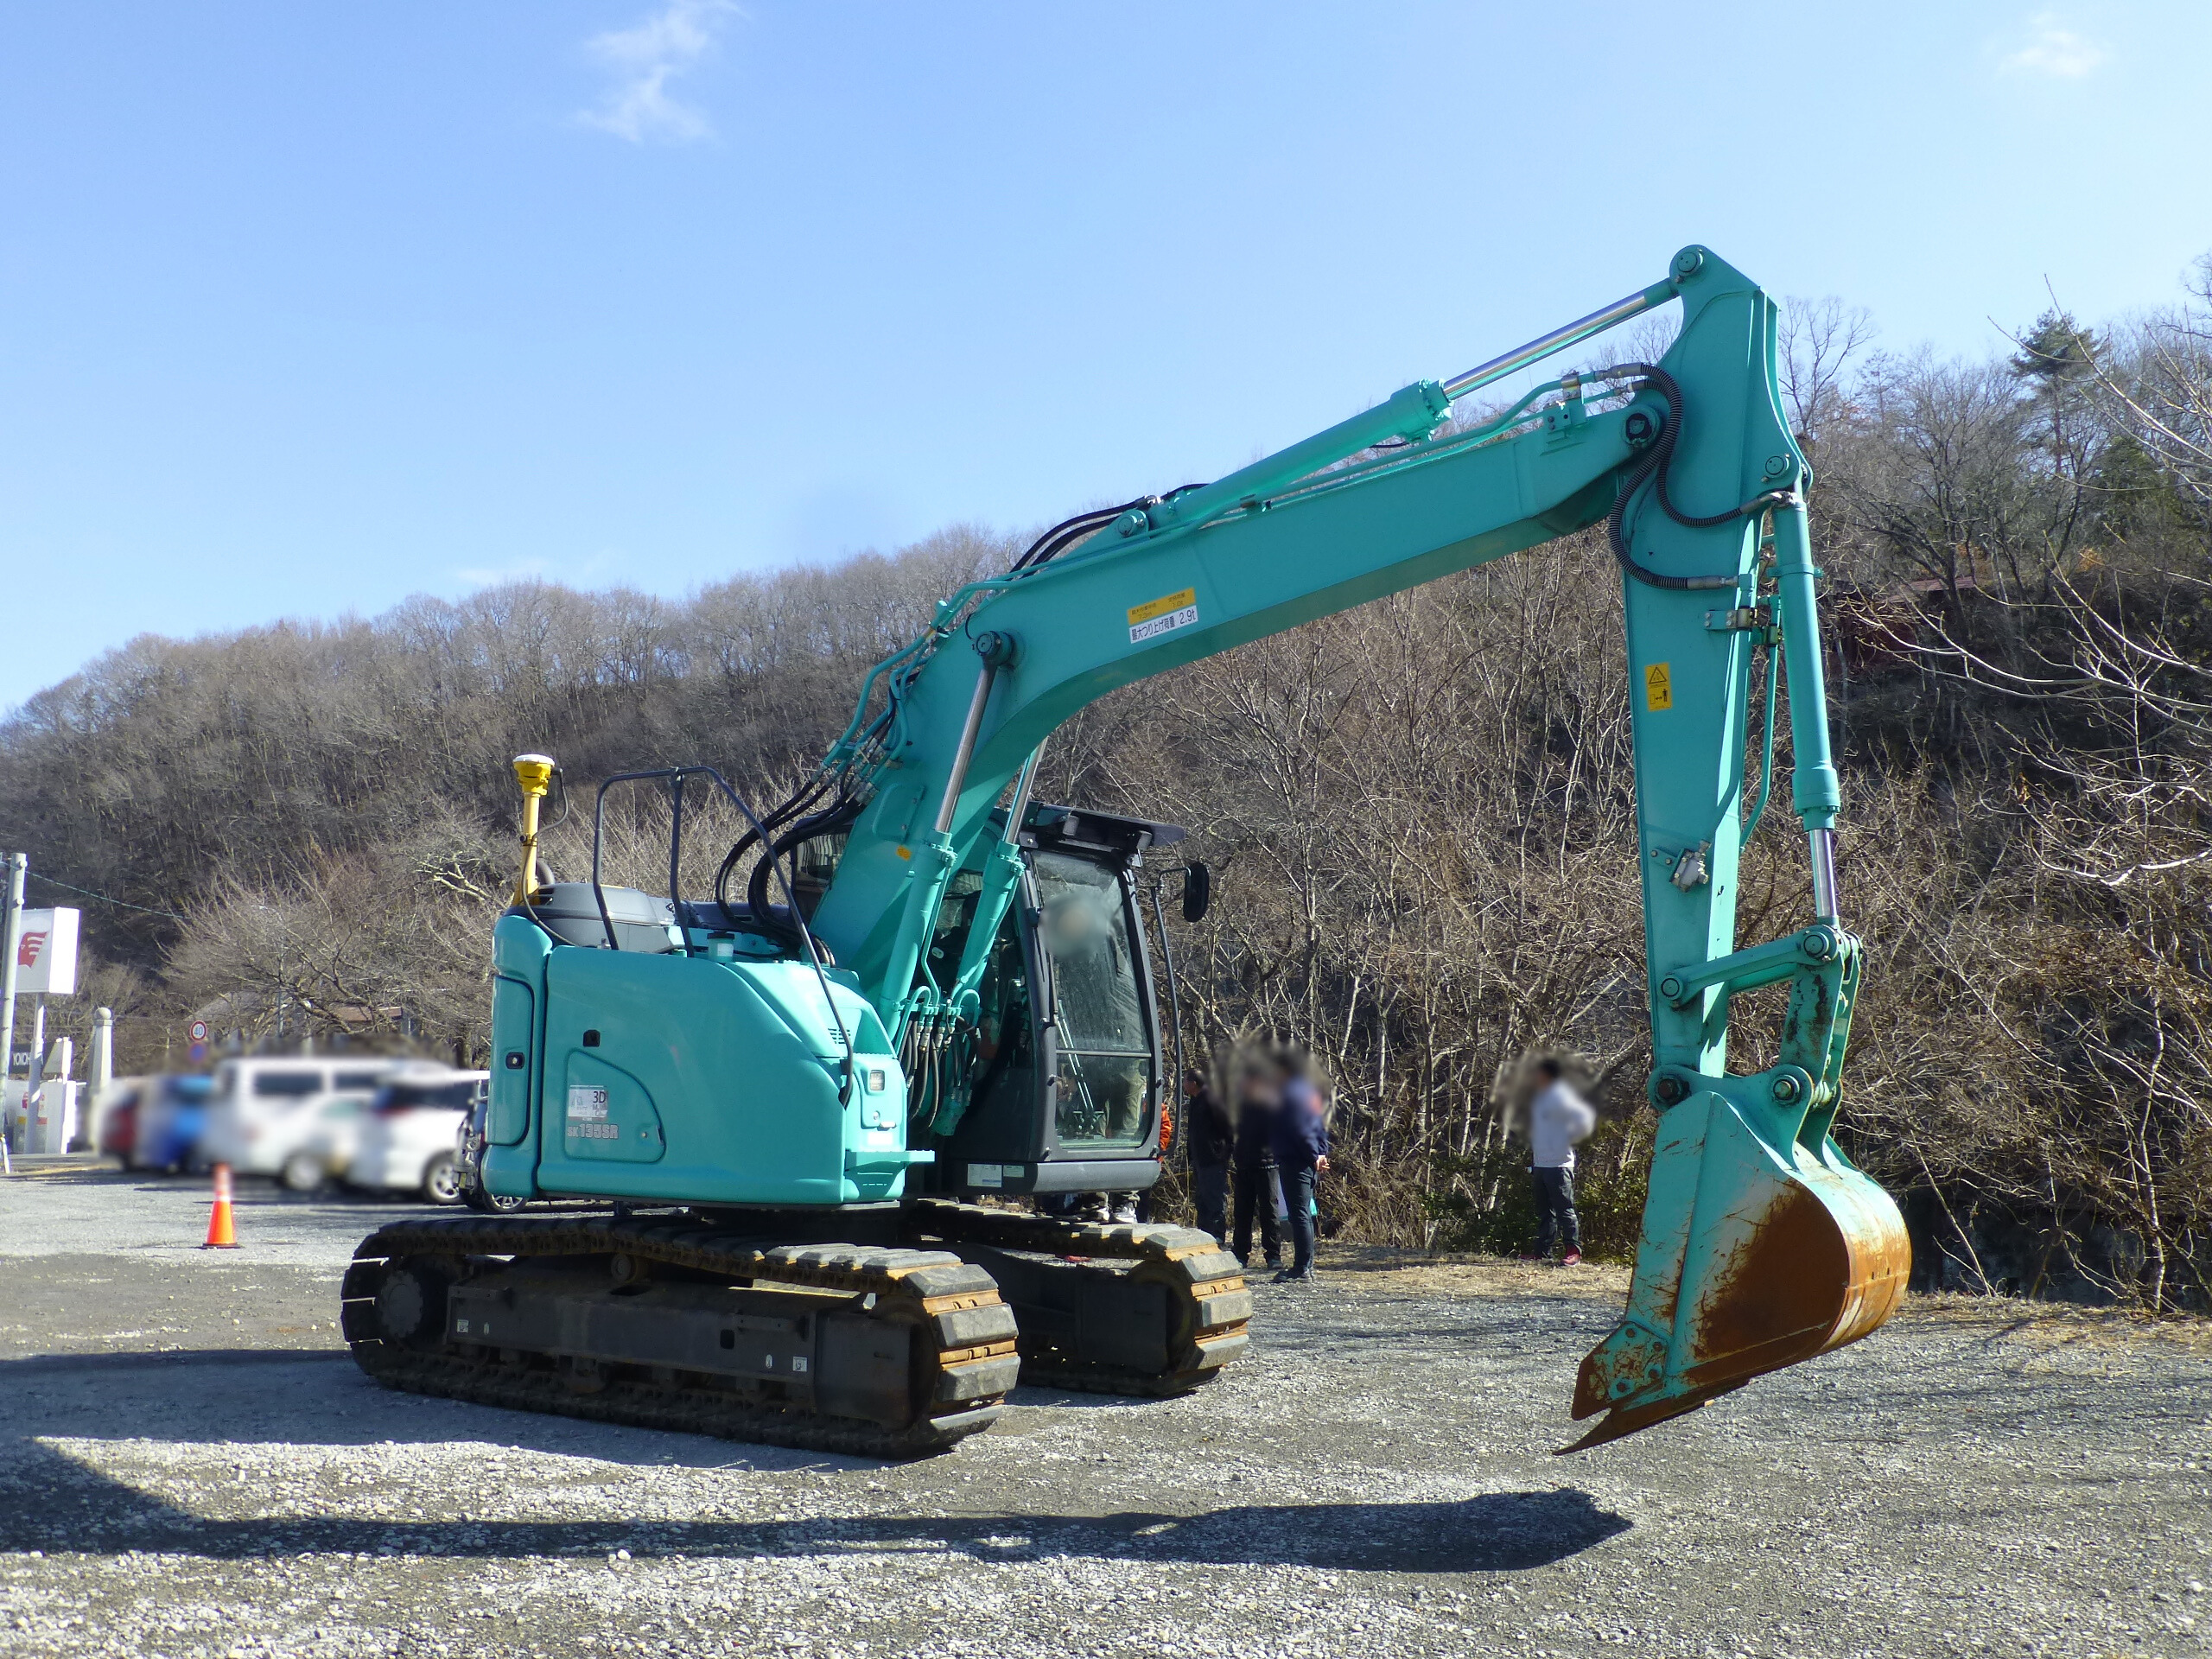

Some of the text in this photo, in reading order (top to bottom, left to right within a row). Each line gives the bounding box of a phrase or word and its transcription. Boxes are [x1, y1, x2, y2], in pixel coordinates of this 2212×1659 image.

[1131, 615, 1175, 640] 最大つり上げ荷重
[1179, 608, 1196, 624] 2.9t
[194, 1026, 203, 1035] 40
[593, 1090, 607, 1103] 3D
[568, 1123, 619, 1139] SK135SR
